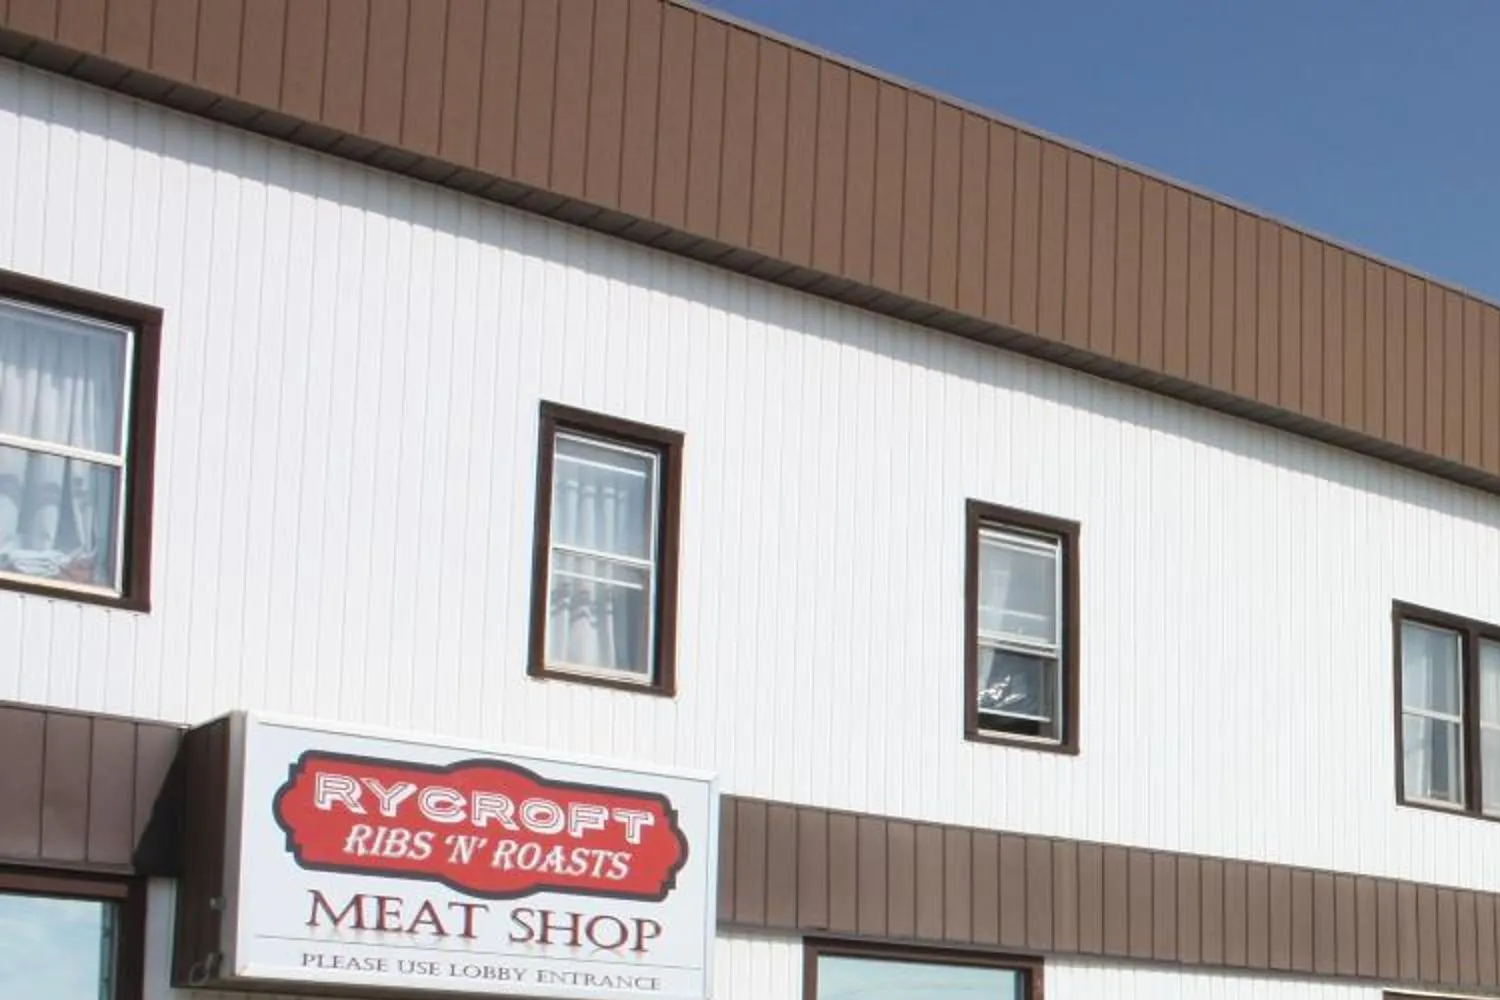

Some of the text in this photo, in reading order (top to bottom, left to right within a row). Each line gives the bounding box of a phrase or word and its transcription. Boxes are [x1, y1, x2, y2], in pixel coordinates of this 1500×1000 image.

[313, 772, 656, 845] RYCROFT
[343, 824, 435, 862] RIBS
[493, 840, 632, 881] ROASTS
[305, 889, 663, 954] MEAT SHOP
[301, 952, 661, 992] PLEASE USE LOBBY ENTRANCE
